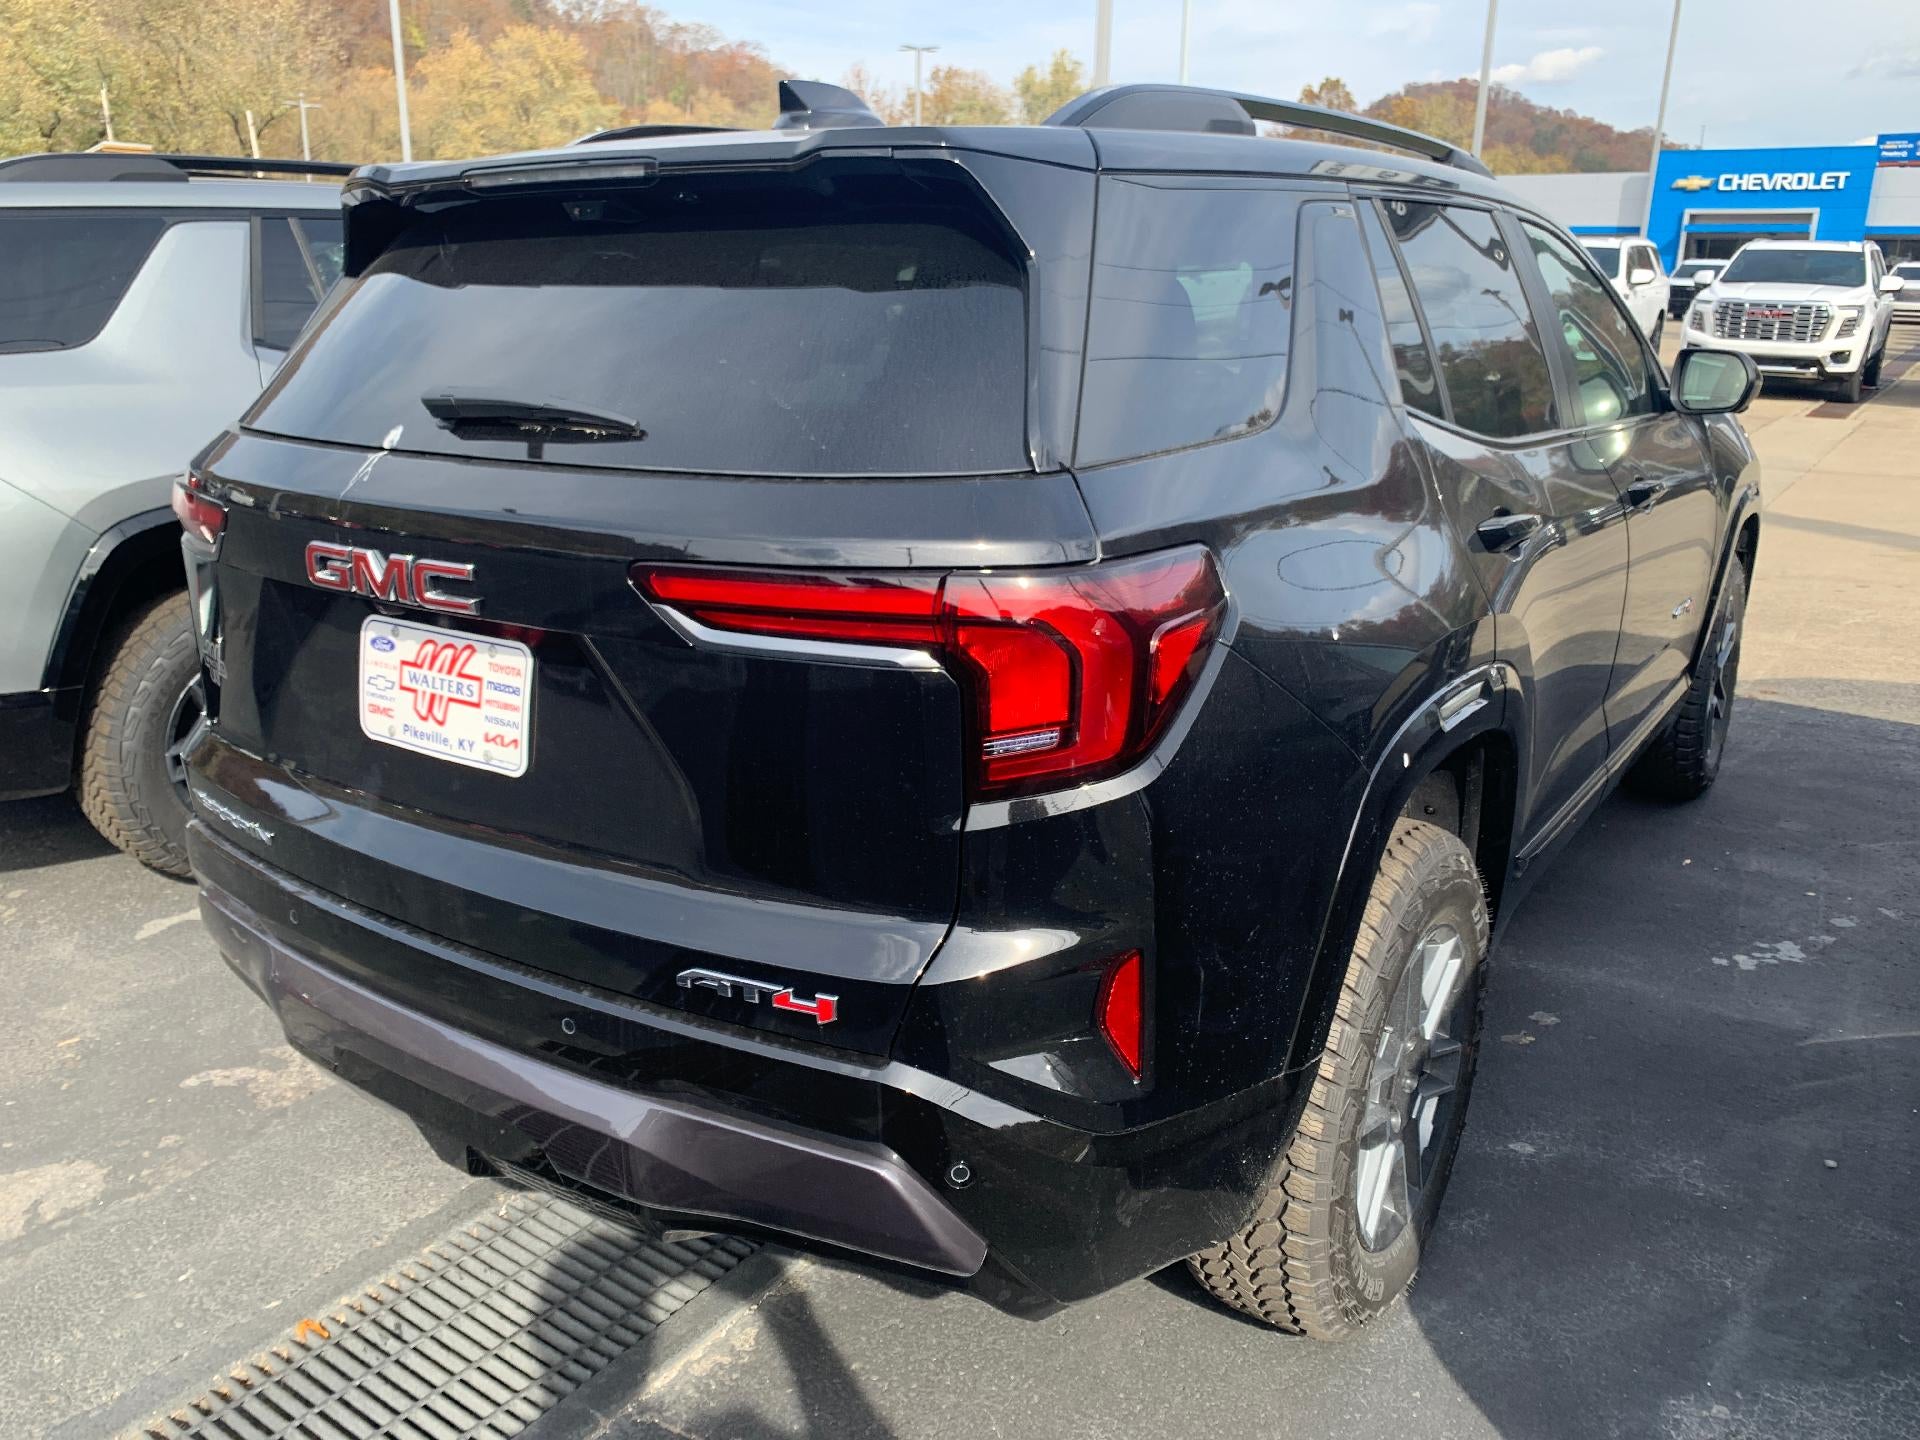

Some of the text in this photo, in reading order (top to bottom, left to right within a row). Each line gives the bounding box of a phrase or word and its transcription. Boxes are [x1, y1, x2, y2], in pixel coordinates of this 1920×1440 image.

[1718, 171, 1851, 191] CHEVROLET
[305, 540, 484, 615] GMC
[487, 661, 522, 678] TOYOTA
[408, 670, 475, 698] WALTERS
[367, 703, 395, 719] GMC
[485, 699, 521, 713] MITSUBISHI
[484, 715, 520, 730] NISSAN
[403, 724, 476, 753] Pikeville, KY
[676, 967, 839, 1025] AT4
